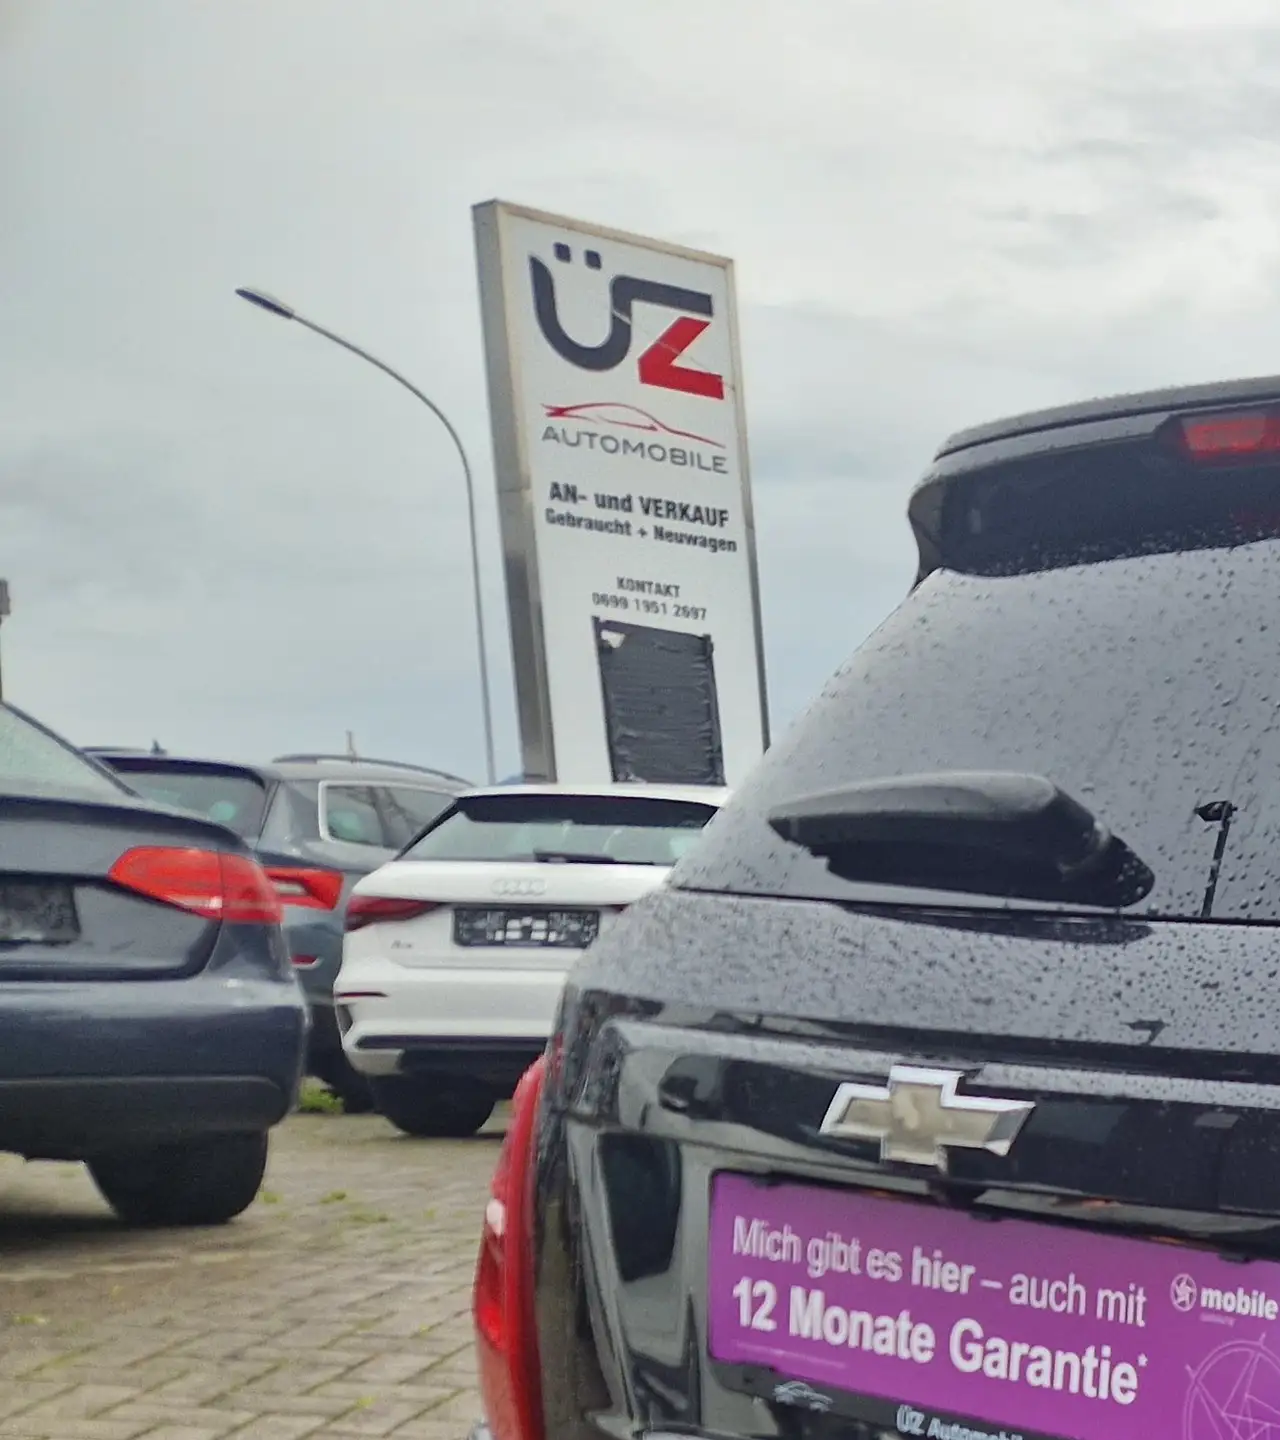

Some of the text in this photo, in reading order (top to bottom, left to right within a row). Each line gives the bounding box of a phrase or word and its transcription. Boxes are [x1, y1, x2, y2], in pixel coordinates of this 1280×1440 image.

[529, 242, 724, 401] ÜZ
[541, 426, 728, 474] AUTOMOBILE
[549, 481, 729, 528] AN- und VERKAUF
[545, 507, 737, 553] Gebraucht + Neuwagen
[616, 576, 680, 598] KONTAKT
[733, 1216, 801, 1264] Mich
[807, 1231, 863, 1279] gibt
[866, 1248, 902, 1282] es
[911, 1245, 976, 1294] hier
[1009, 1272, 1086, 1316] auch
[1096, 1282, 1147, 1328] mit
[733, 1276, 777, 1332] 12
[789, 1285, 936, 1361] Monate
[1201, 1287, 1279, 1320] mobile
[896, 1403, 925, 1436] ÜZ
